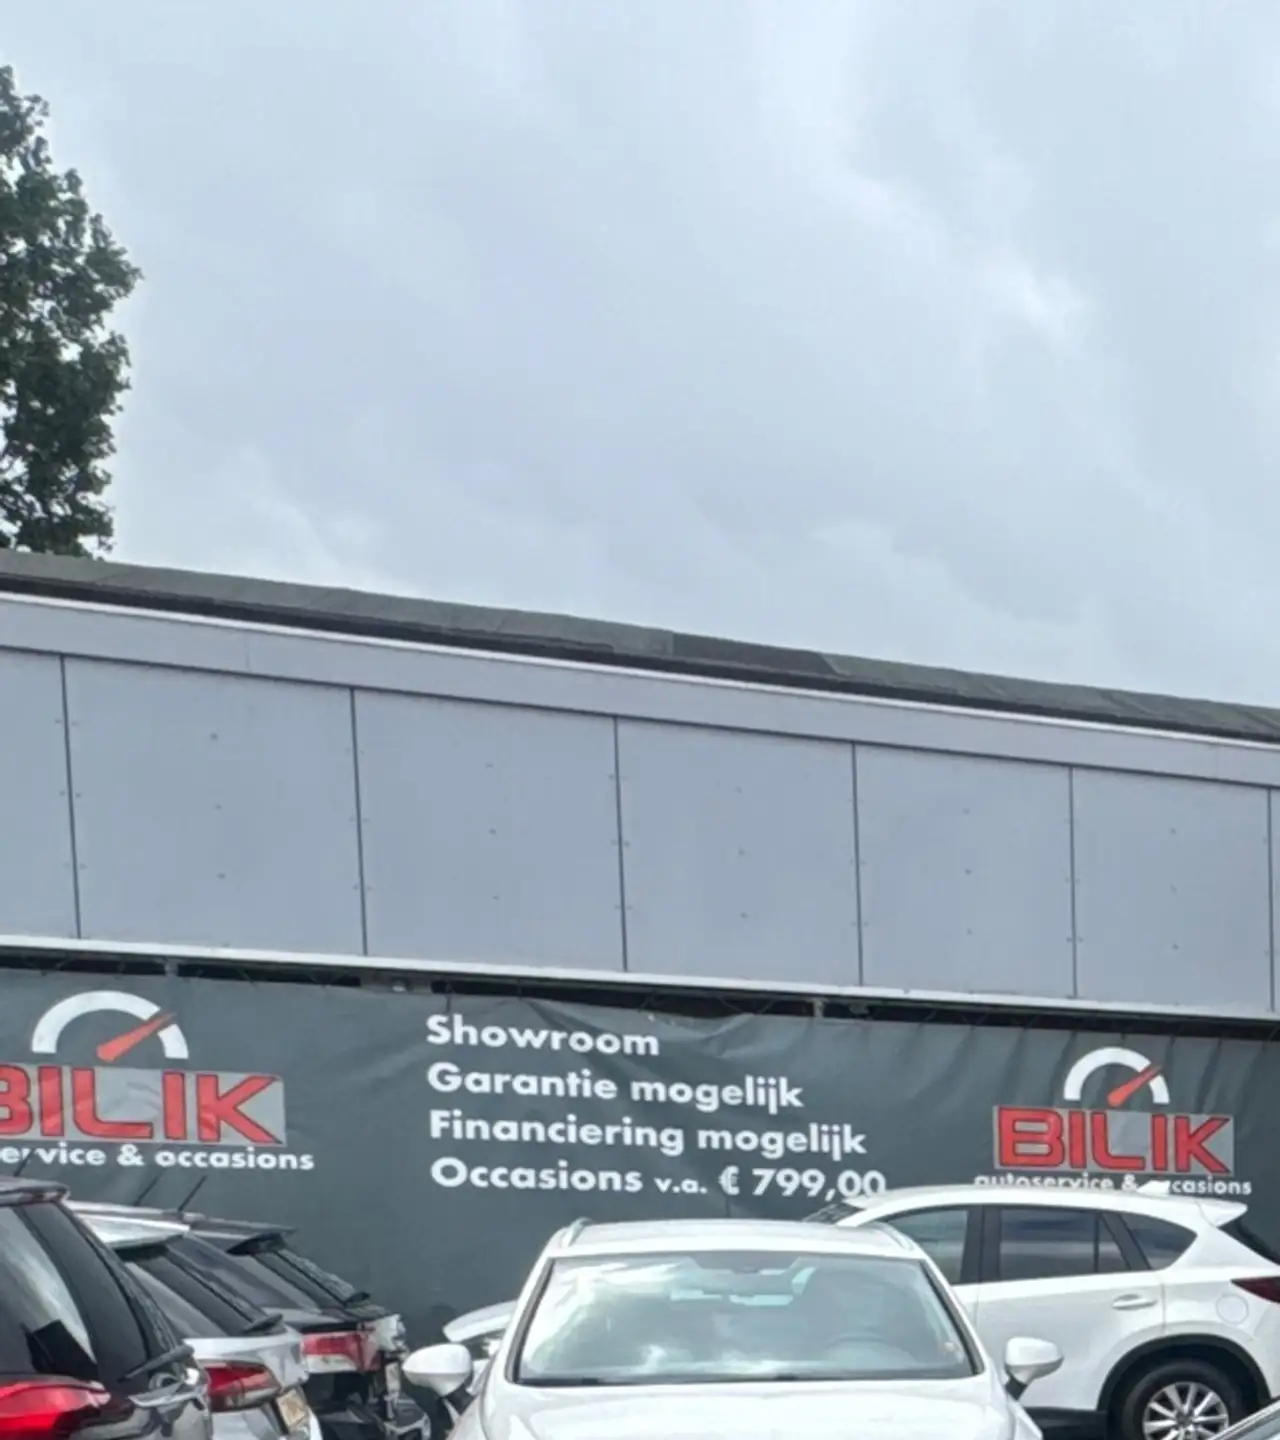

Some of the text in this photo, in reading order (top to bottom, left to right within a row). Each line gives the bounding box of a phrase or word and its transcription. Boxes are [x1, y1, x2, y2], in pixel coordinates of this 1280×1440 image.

[426, 1014, 660, 1056] Showroom
[427, 1062, 805, 1115] Garantie mogelijk
[117, 1144, 145, 1167] &
[155, 1147, 316, 1171] occasions
[429, 1109, 868, 1162] Financiering mogelijk
[998, 1107, 1231, 1174] BILIK
[430, 1156, 887, 1201] Occasions v.a. € 799,00
